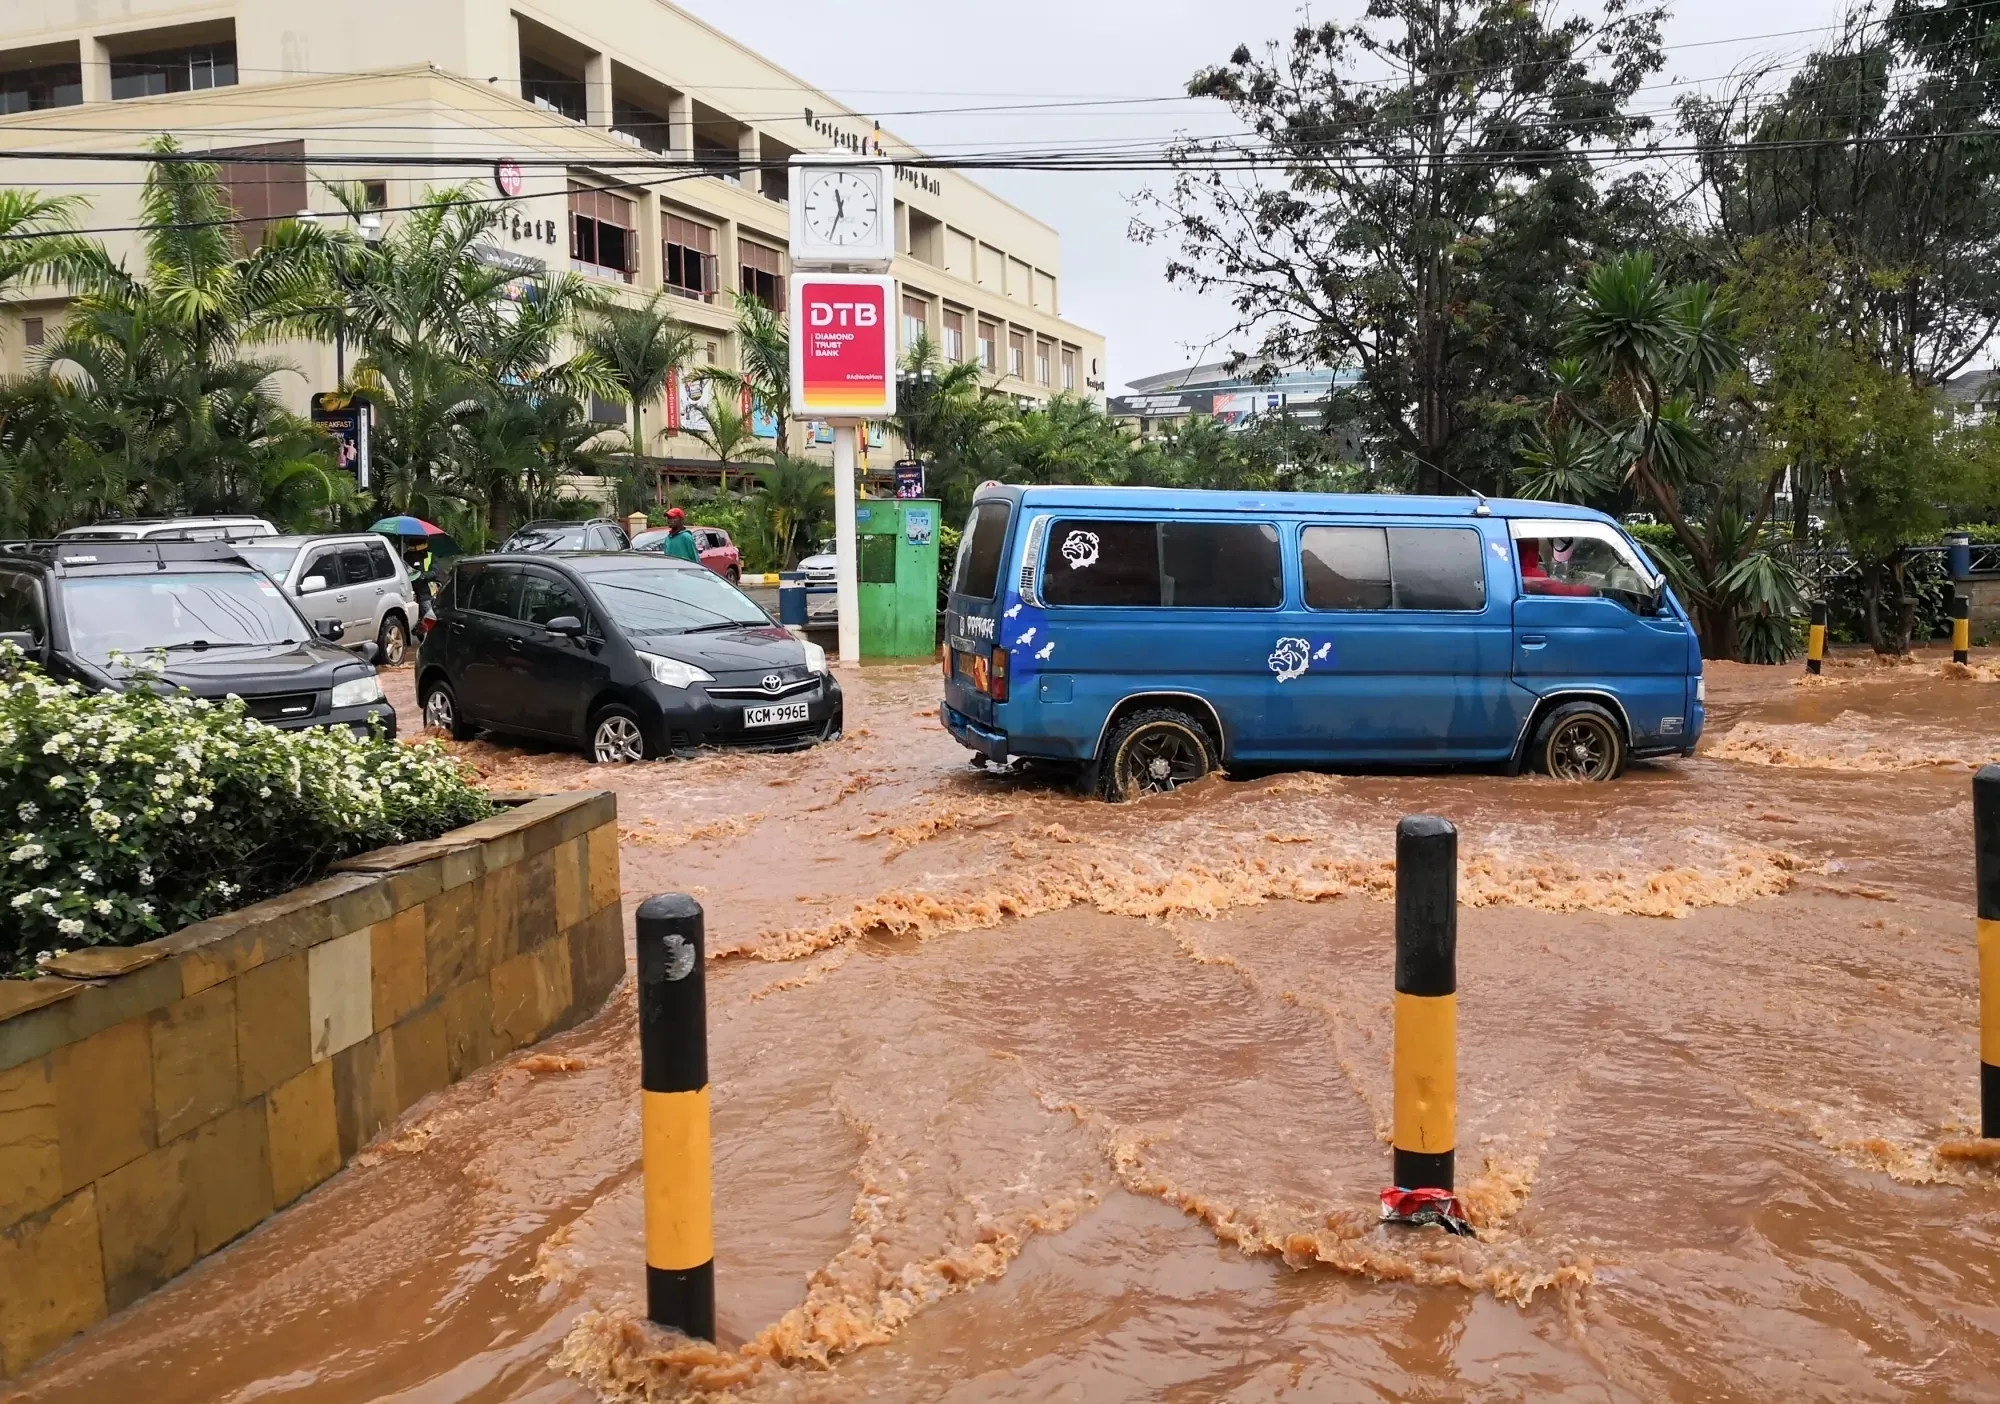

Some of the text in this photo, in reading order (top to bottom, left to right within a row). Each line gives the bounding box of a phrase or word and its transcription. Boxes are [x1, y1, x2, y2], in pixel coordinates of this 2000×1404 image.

[920, 172, 940, 196] Mall
[811, 303, 877, 326] DTB
[815, 341, 843, 349] TRUST
[815, 349, 840, 357] BANK
[747, 705, 806, 723] KCM 996E
